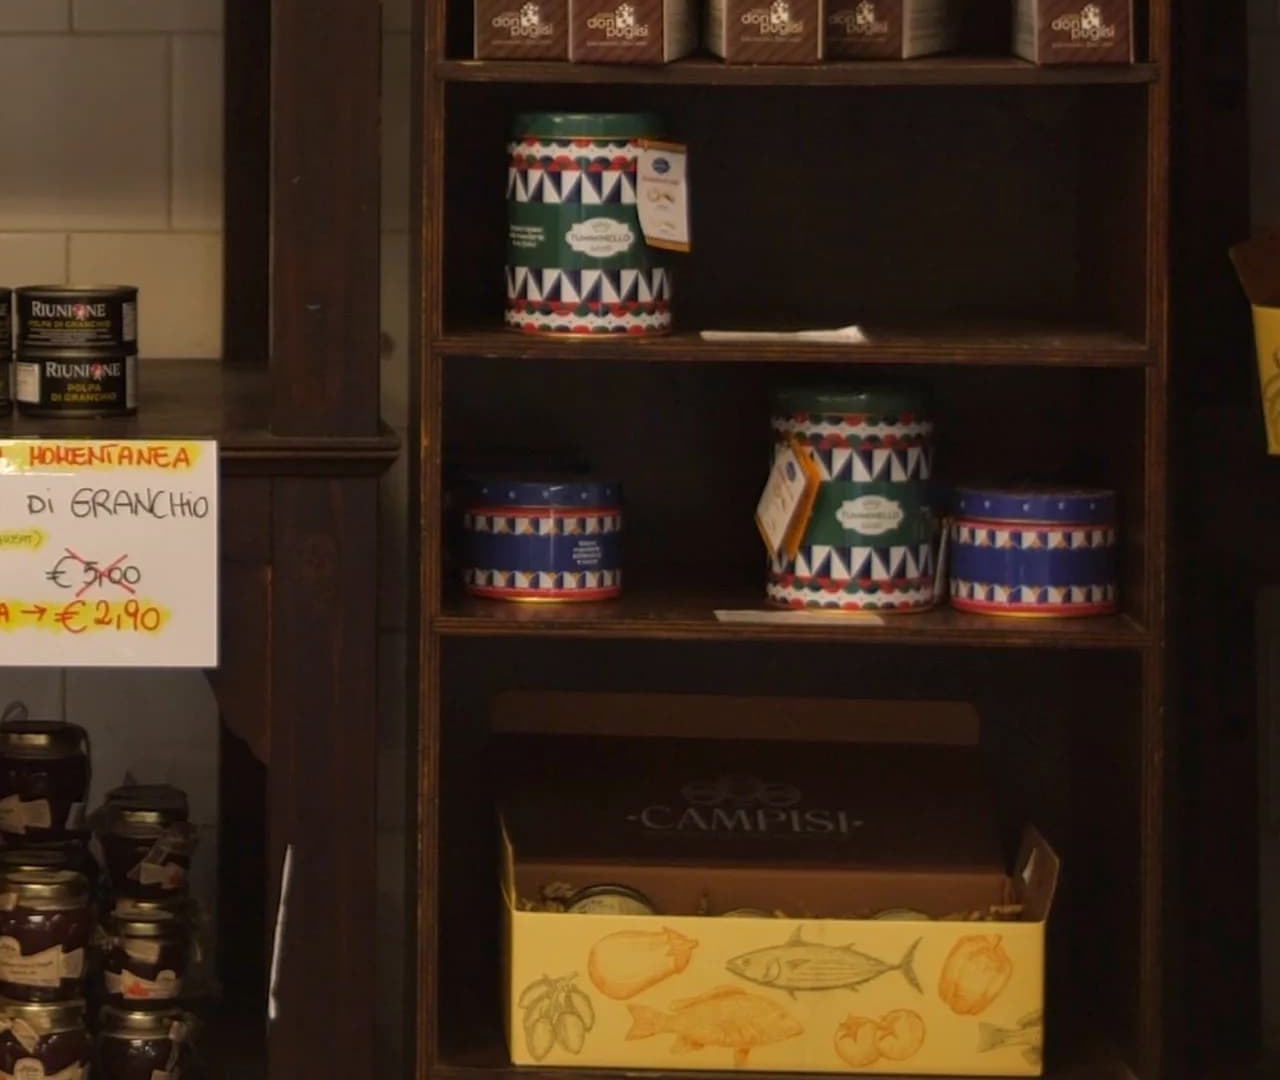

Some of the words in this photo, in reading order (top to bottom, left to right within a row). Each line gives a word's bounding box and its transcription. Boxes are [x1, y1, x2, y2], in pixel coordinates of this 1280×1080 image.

[587, 15, 616, 29] don
[1052, 16, 1080, 30] don
[45, 556, 75, 588] €
[83, 560, 141, 587] 5,00
[54, 599, 87, 633] €
[94, 599, 161, 631] 2,90
[640, 805, 849, 833] CAMPISI
